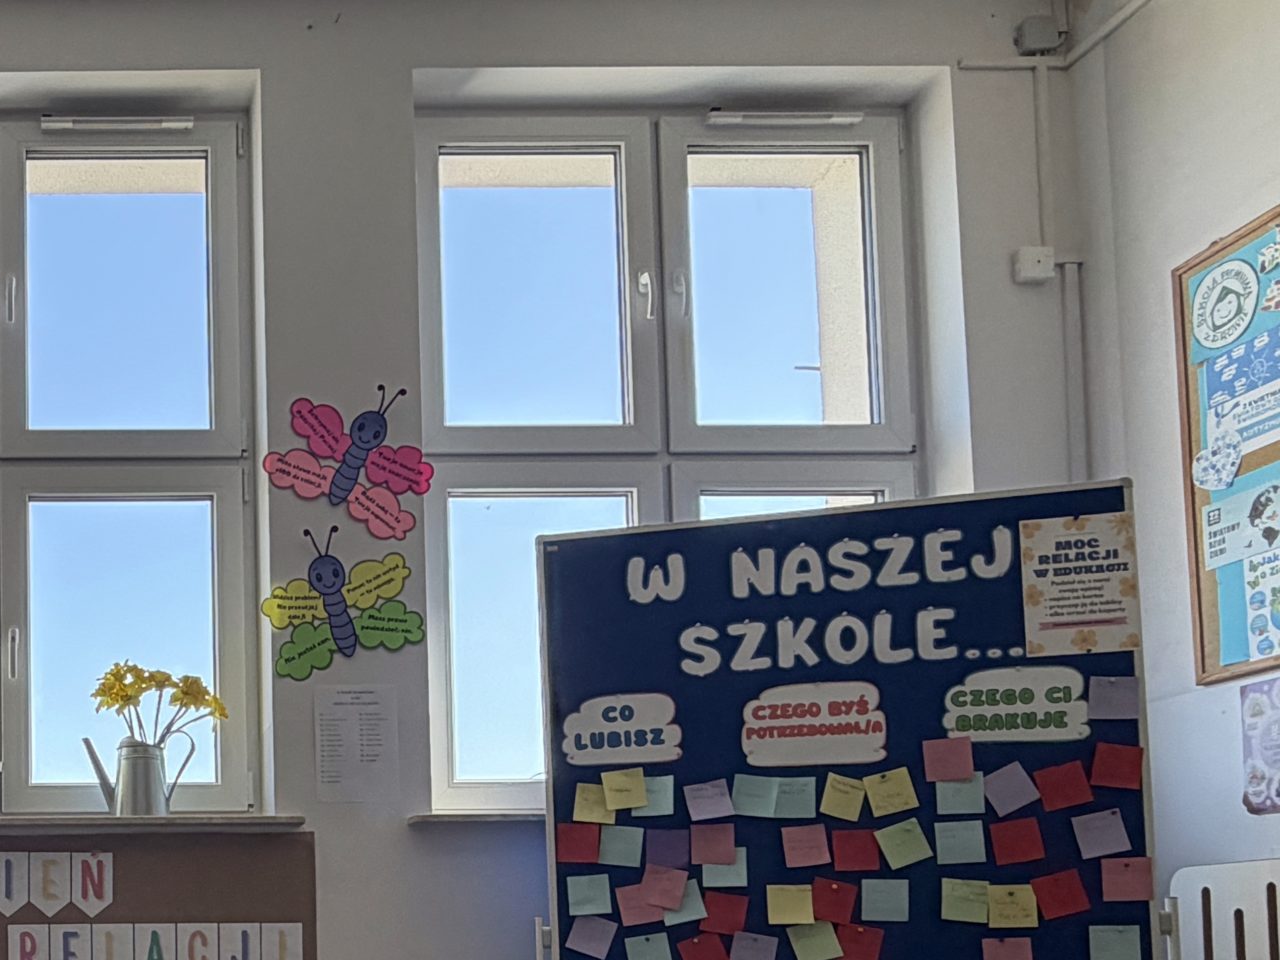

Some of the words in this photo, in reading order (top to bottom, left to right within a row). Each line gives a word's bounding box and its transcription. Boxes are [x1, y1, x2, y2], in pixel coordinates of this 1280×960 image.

[1055, 538, 1100, 551] MOC
[627, 553, 686, 604] W
[730, 525, 1014, 600] NASZEJ
[1038, 549, 1119, 565] RELACJI
[1033, 569, 1050, 578] W
[1053, 562, 1129, 577] EDUKACJI
[950, 687, 1035, 707] CZEGO
[1044, 686, 1073, 704] CI
[601, 704, 635, 723] CO
[751, 702, 822, 721] CZEGO
[827, 694, 870, 717] BYŚ
[954, 711, 1068, 732] BRAKUJE
[574, 728, 665, 751] LUBISZ
